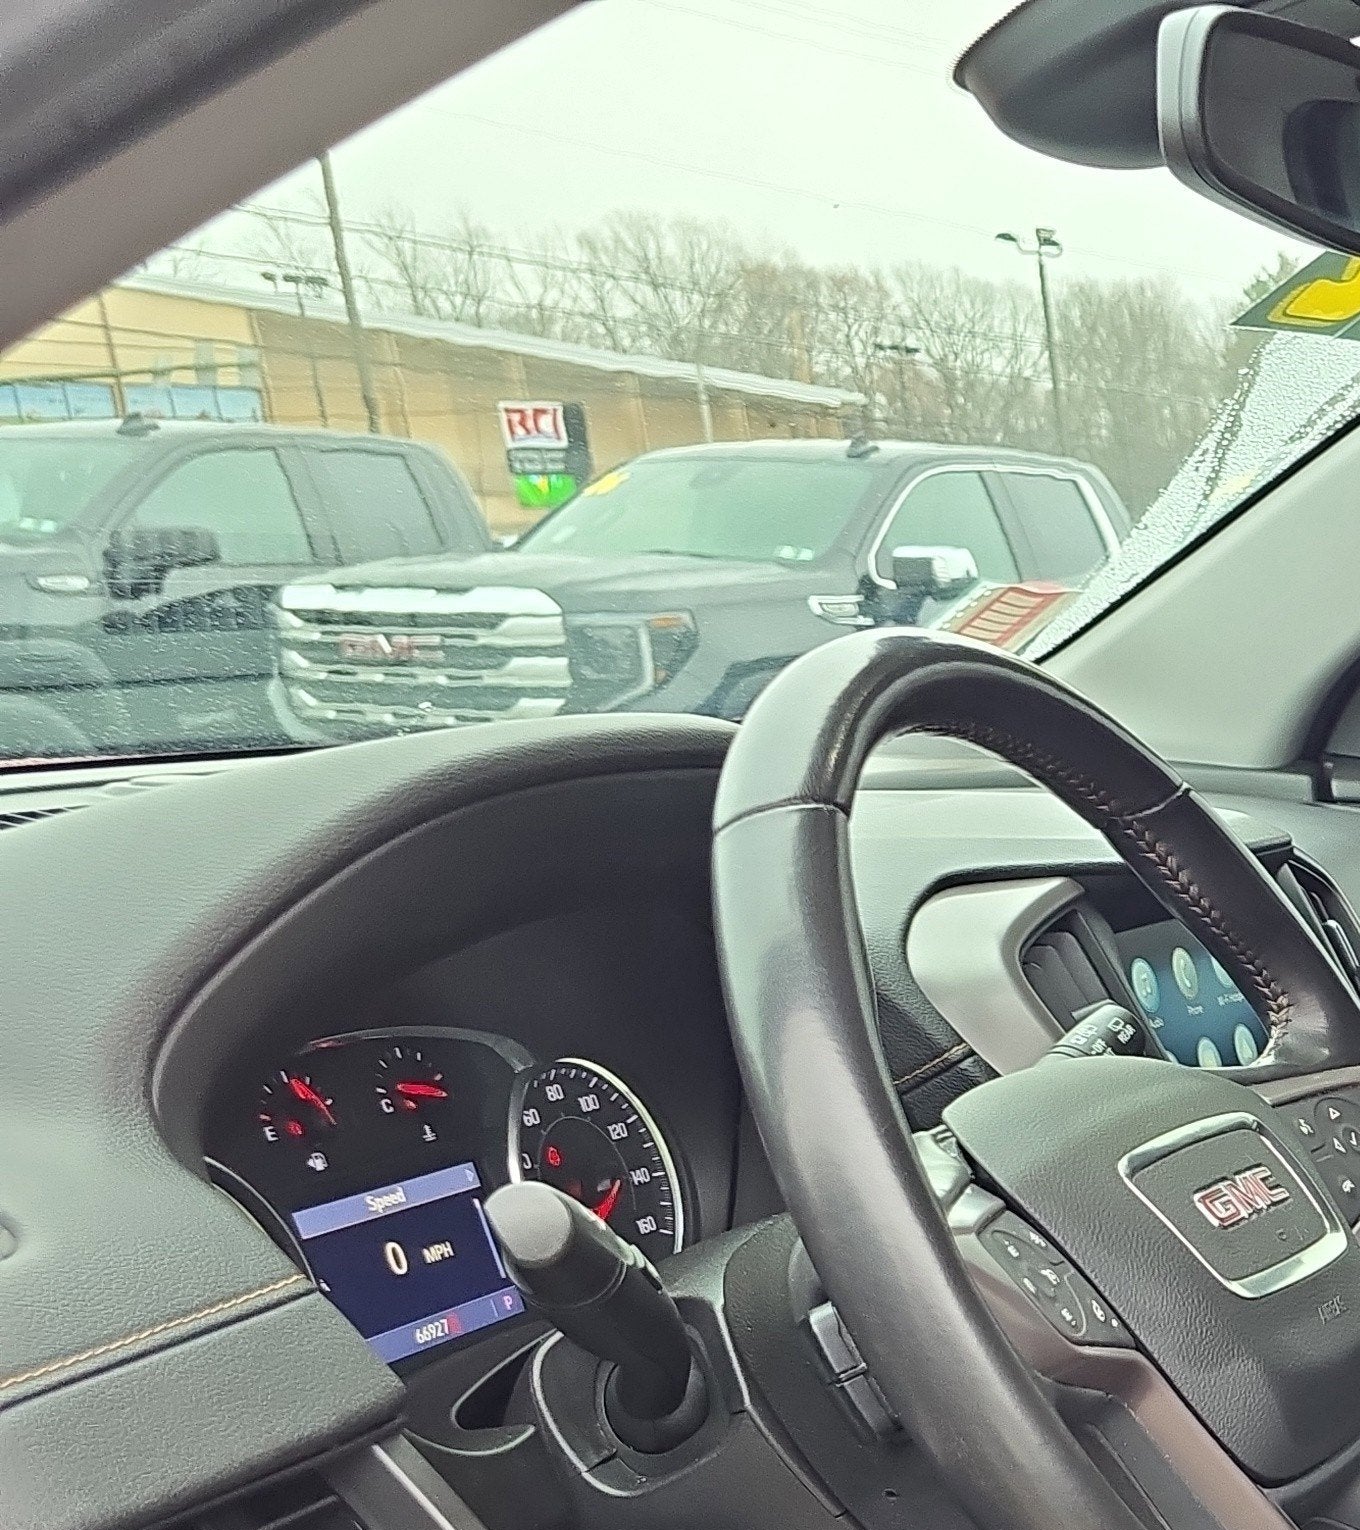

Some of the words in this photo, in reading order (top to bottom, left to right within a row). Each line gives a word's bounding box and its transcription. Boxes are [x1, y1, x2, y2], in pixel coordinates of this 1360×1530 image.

[545, 1083, 564, 1102] 80
[578, 1094, 600, 1113] 100
[522, 1108, 541, 1127] 60
[263, 1125, 279, 1142] E
[606, 1122, 628, 1140] 120
[630, 1167, 651, 1186] 140
[364, 1185, 407, 1214] Speed
[1193, 1165, 1290, 1228] GMC
[635, 1215, 657, 1235] 160
[384, 1241, 409, 1276] 0
[422, 1241, 454, 1264] MPH
